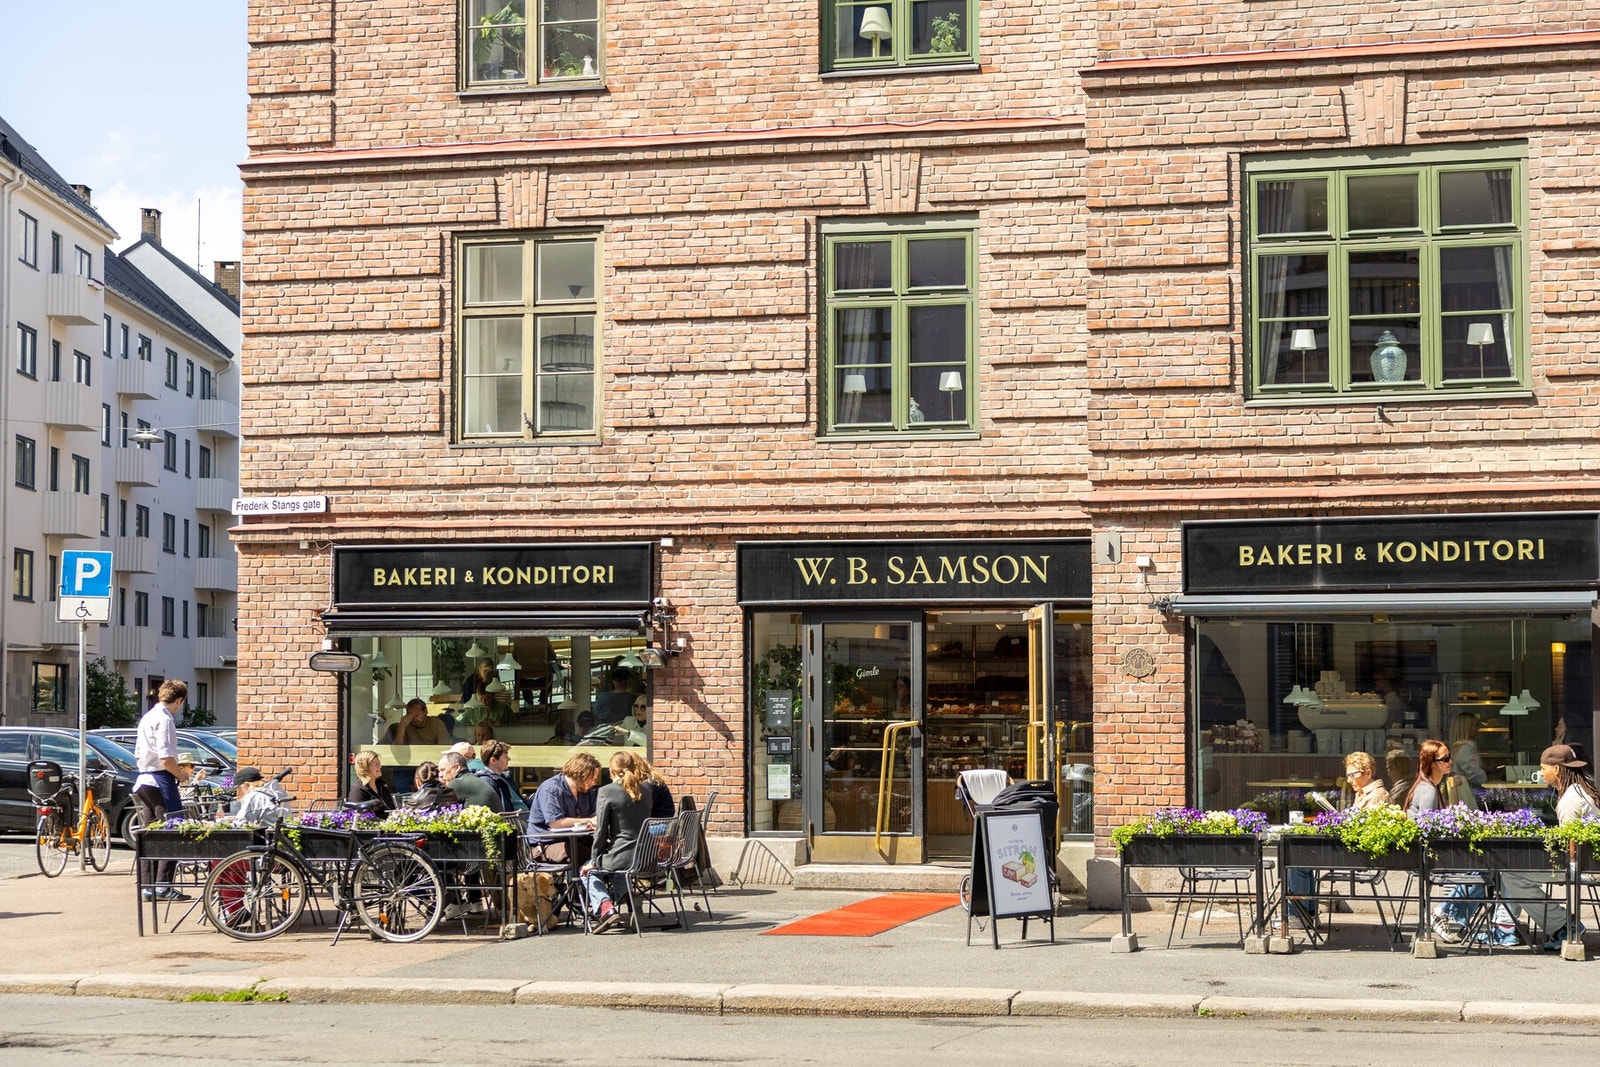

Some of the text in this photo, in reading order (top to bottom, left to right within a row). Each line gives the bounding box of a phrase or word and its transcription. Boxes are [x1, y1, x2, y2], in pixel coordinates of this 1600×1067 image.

[235, 499, 321, 512] Frederik Stangs gate
[1238, 538, 1545, 567] BAKERI & KONDITORI
[75, 557, 101, 592] P
[373, 565, 614, 586] BAKERI & KONDITORI
[793, 555, 1050, 586] W. B. SAMSON
[856, 665, 880, 680] Gimle
[997, 844, 1037, 860] SITRON
